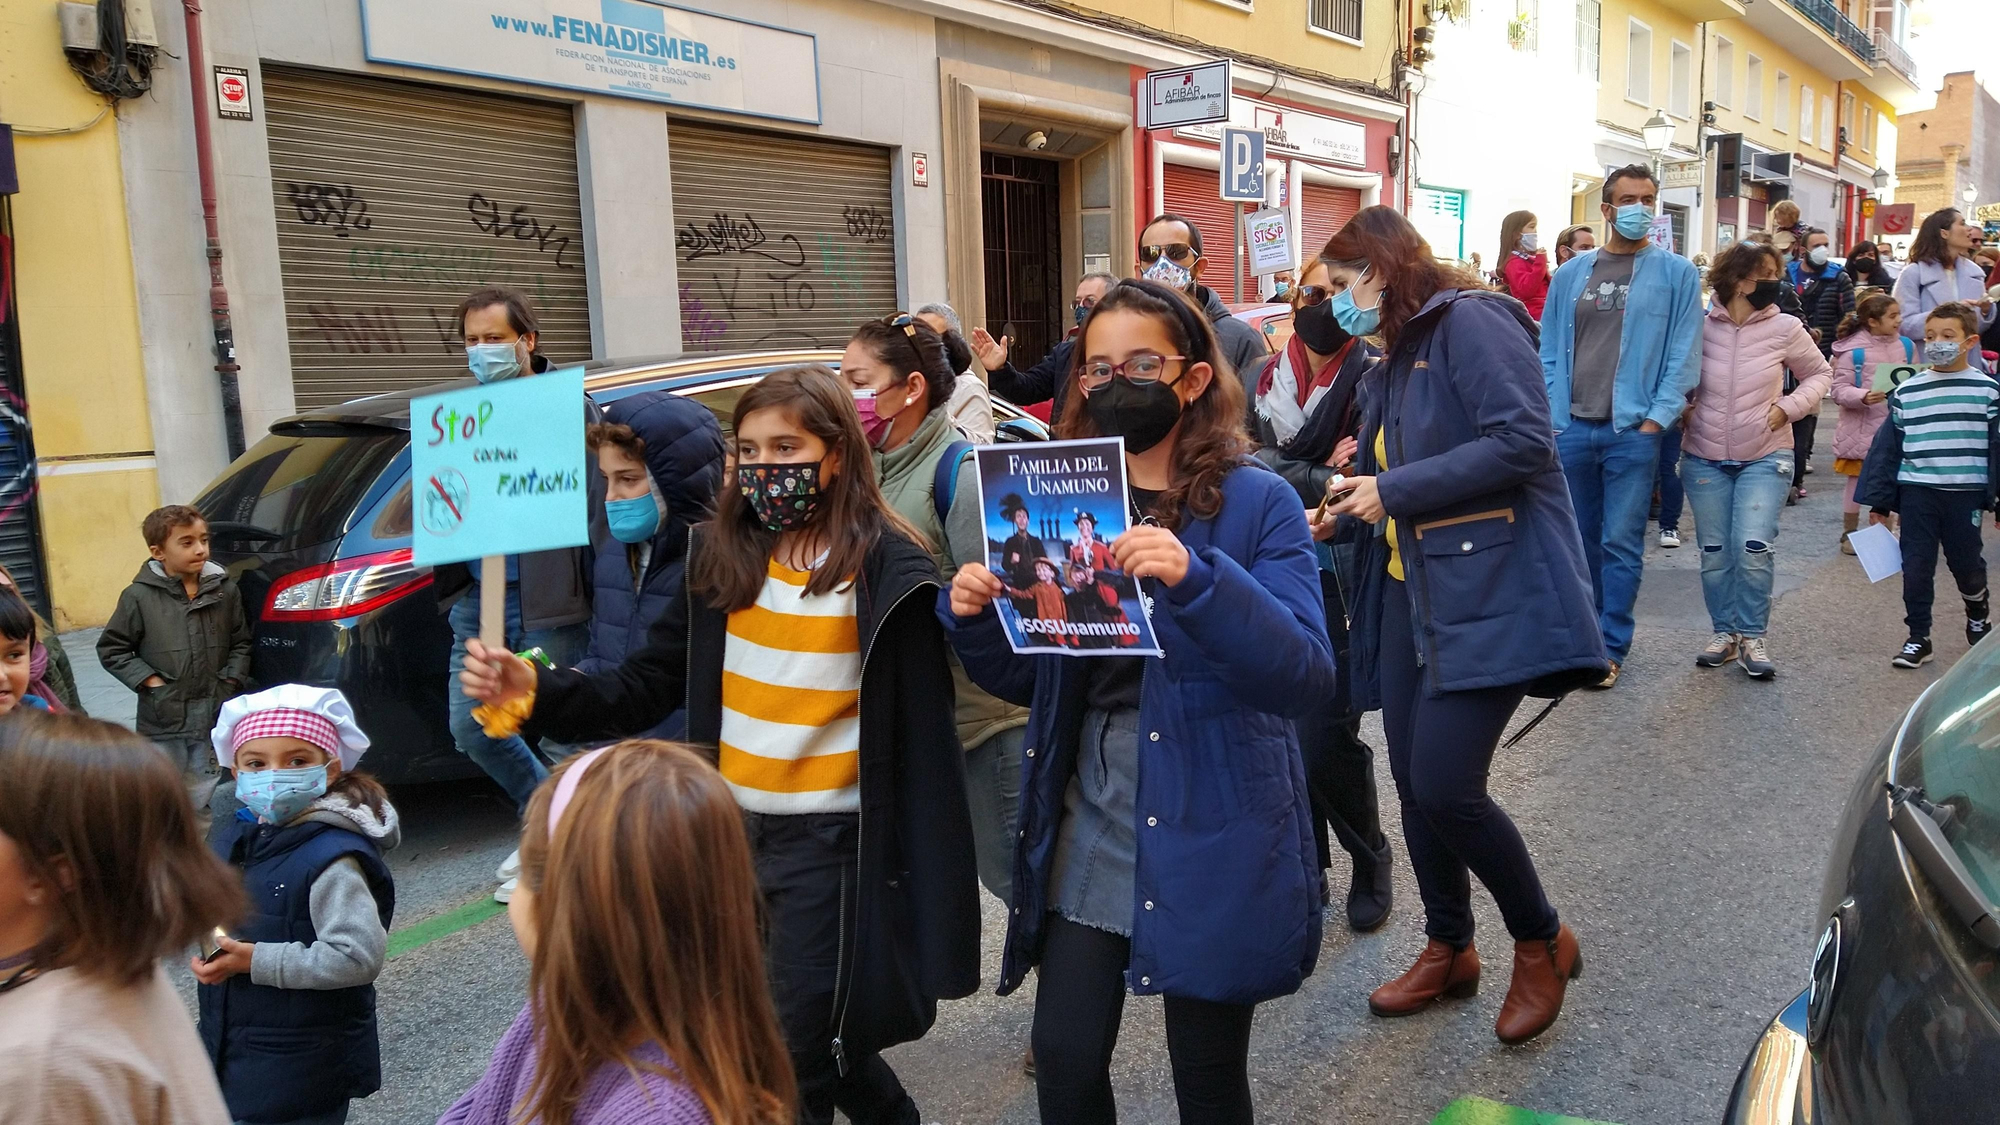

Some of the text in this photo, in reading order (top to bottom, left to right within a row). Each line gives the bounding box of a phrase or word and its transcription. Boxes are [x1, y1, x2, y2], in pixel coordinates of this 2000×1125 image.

[491, 14, 736, 70] www.FENADISMER.es
[555, 48, 711, 81] FEDERACION NACIONAL DE ASOCIACIONES
[585, 63, 688, 86] DE TRANSPORTE DE ESPAÑA
[223, 83, 243, 95] STOP
[626, 80, 652, 90] ANEXO
[1164, 85, 1201, 100] AFIBAR
[1231, 133, 1252, 192] P
[1256, 161, 1264, 176] 2
[1254, 225, 1284, 243] STOP
[1008, 454, 1109, 476] FAMILIA DEL
[1026, 475, 1110, 497] UNAMUNO
[1015, 617, 1142, 637] #SOSUnamuno
